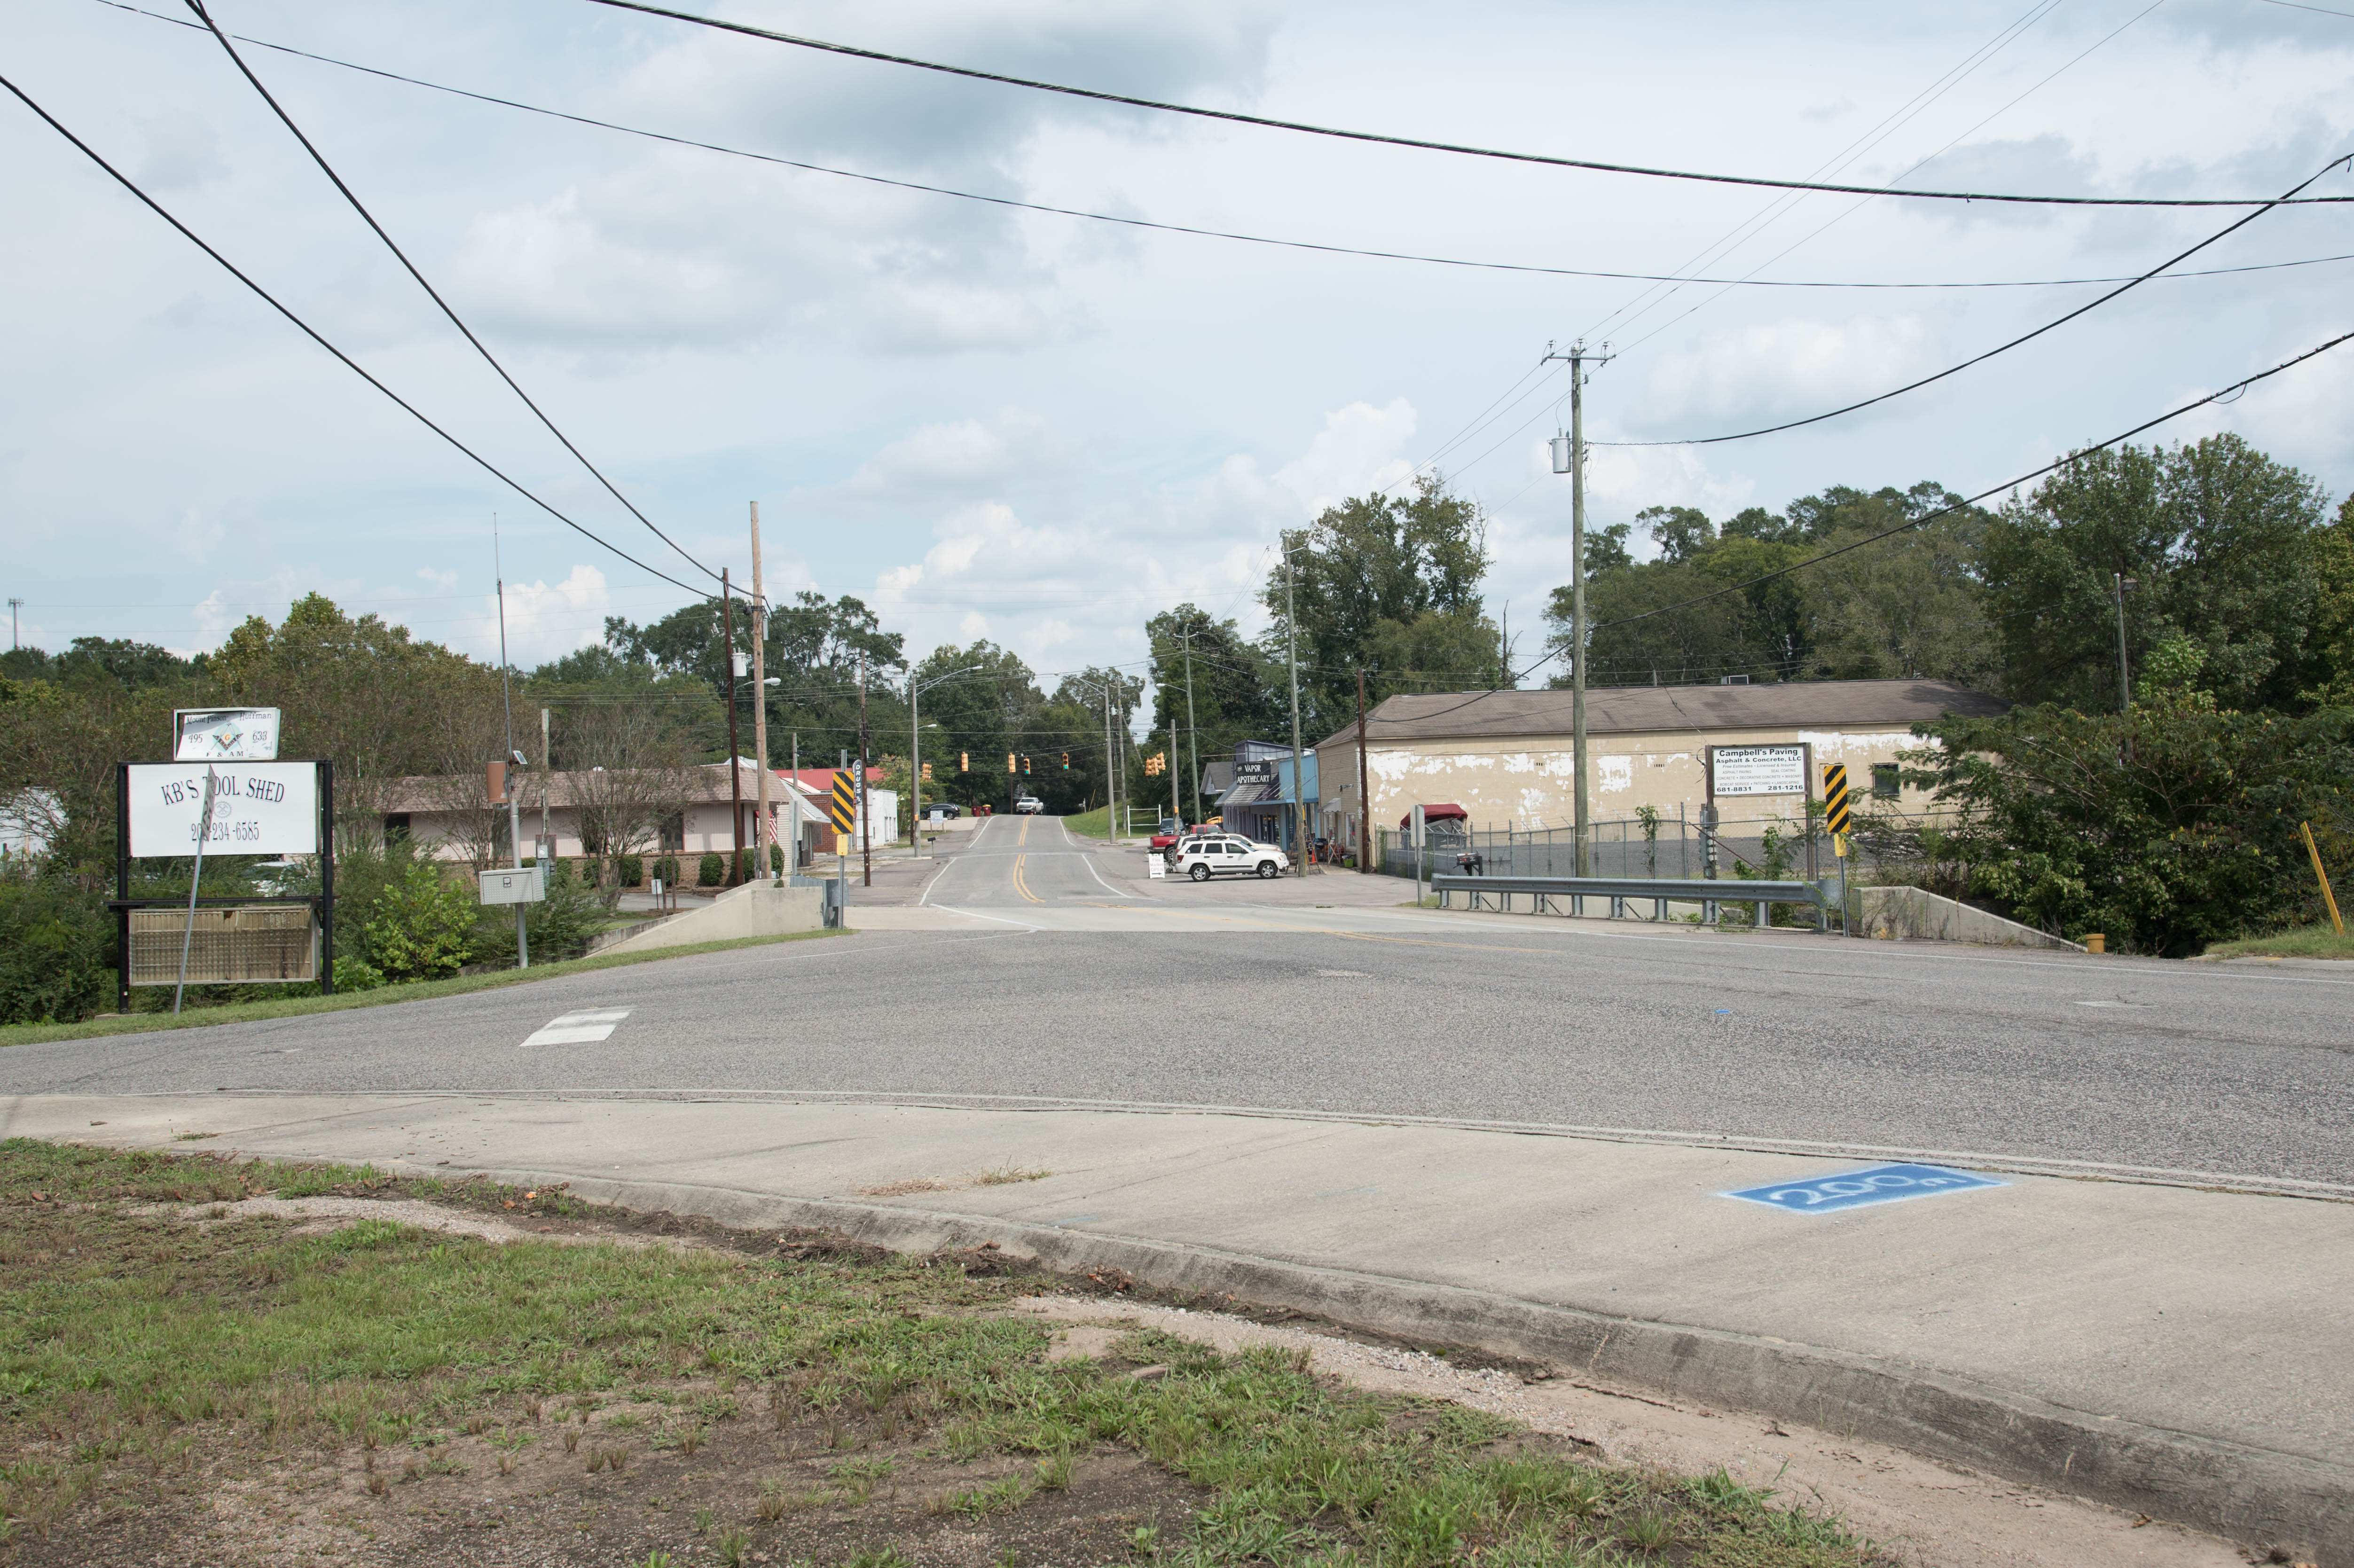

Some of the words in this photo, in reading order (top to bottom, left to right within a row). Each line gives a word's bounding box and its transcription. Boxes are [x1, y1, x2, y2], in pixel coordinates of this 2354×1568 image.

[240, 712, 272, 721] Huffman
[188, 734, 203, 744] 495
[252, 731, 267, 741] 633
[1244, 764, 1261, 772] VAPOR
[1237, 775, 1270, 784] APOTHECARY
[161, 779, 199, 805] KB'S
[246, 777, 284, 803] SHED
